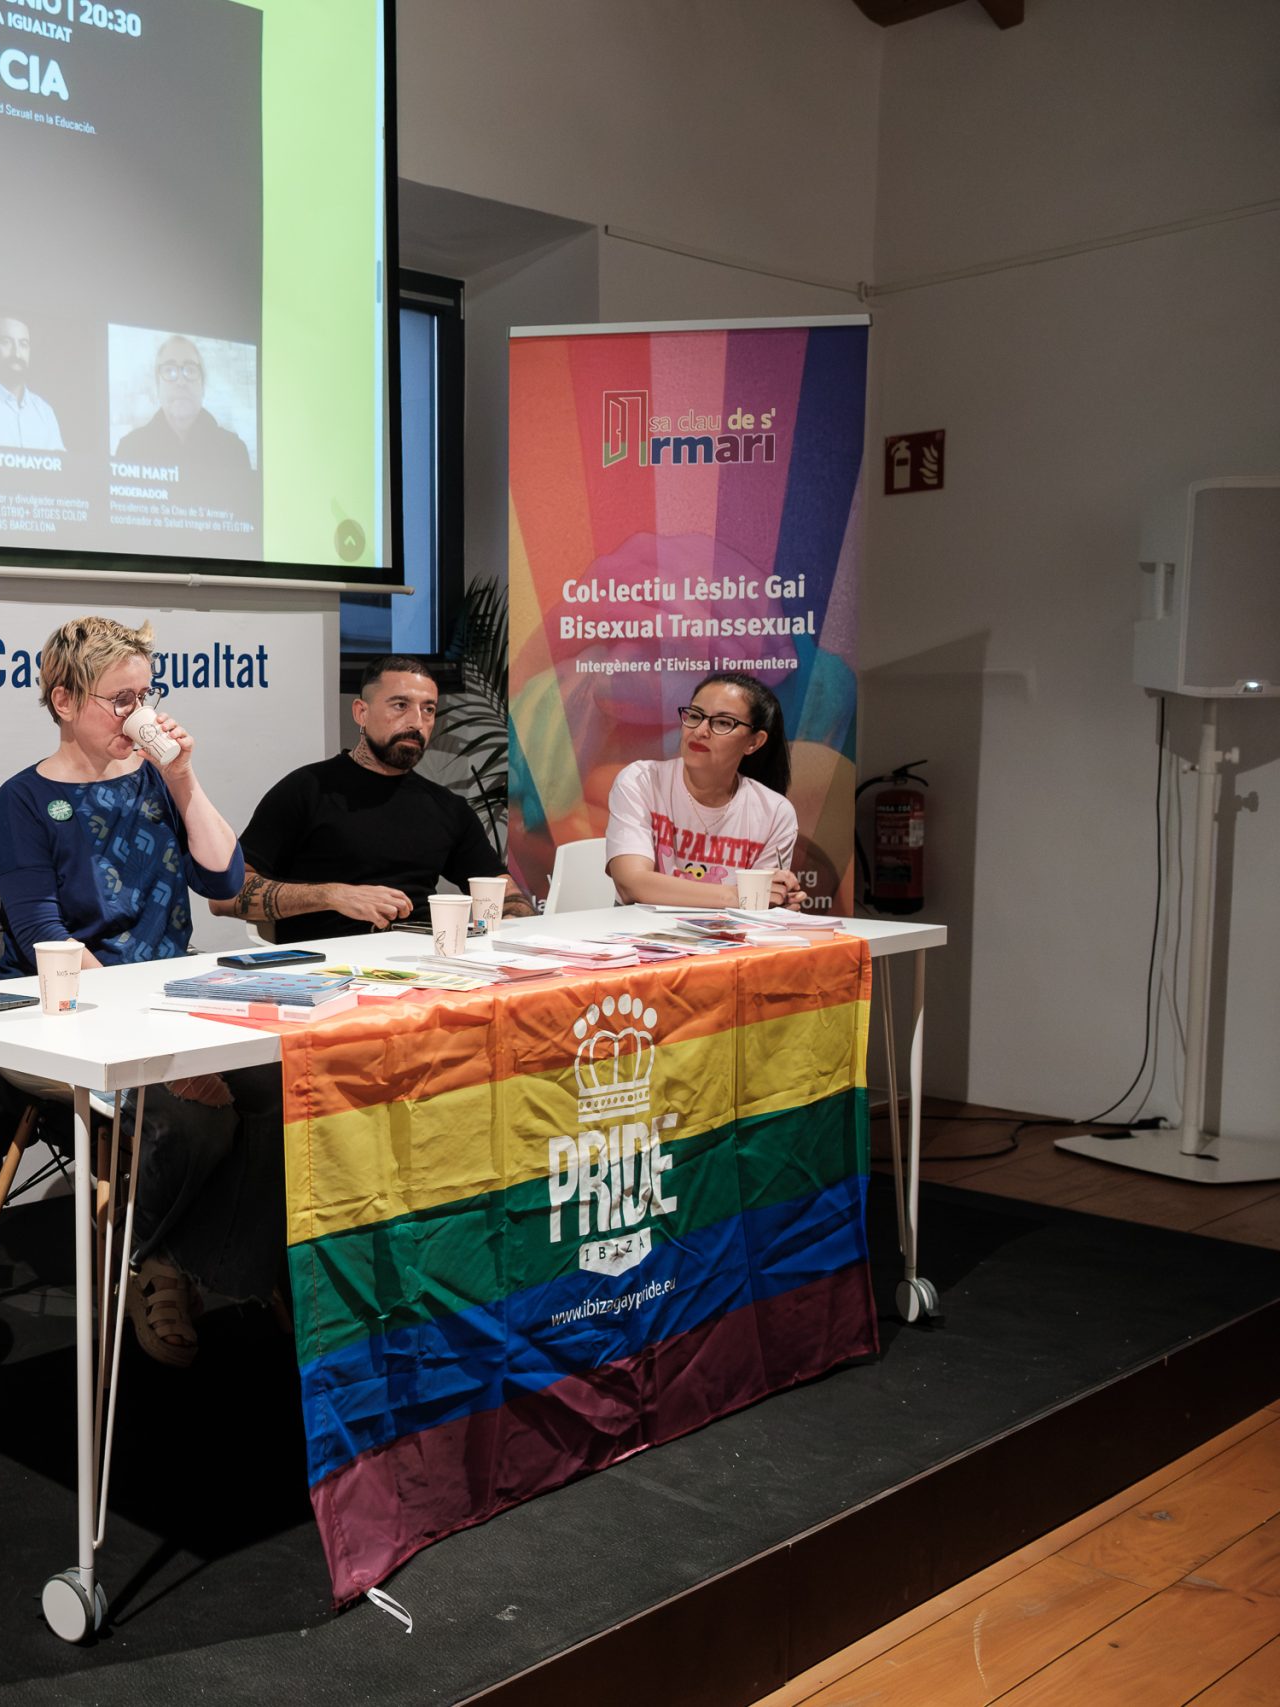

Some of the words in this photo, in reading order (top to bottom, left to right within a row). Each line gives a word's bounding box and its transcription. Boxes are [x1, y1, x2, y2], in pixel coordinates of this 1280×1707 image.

[7, 11, 73, 43] IGUALTAT
[80, 0, 142, 37] 20:30
[5, 104, 33, 121] Sexual
[34, 111, 45, 125] en
[45, 112, 54, 125] la
[649, 414, 672, 433] sa
[677, 408, 721, 432] clau
[727, 407, 755, 430] de
[760, 407, 776, 430] s'
[110, 462, 140, 479] TONI
[142, 465, 180, 482] MARTÍ
[110, 484, 169, 500] MODERADOR
[10, 519, 57, 533] BARCELONA
[62, 510, 88, 522] COLOR
[683, 575, 759, 601] Lèsbic
[764, 574, 806, 599] Gai
[560, 612, 664, 640] Bisexual
[669, 610, 816, 638] Transsexual
[575, 658, 651, 676] Intergènere
[713, 656, 719, 671] i
[722, 656, 799, 671] Formentera
[548, 1112, 679, 1244] PRIDE
[584, 1236, 645, 1263] IBIZA
[551, 1277, 676, 1327] www.ibizagaypride.eu
